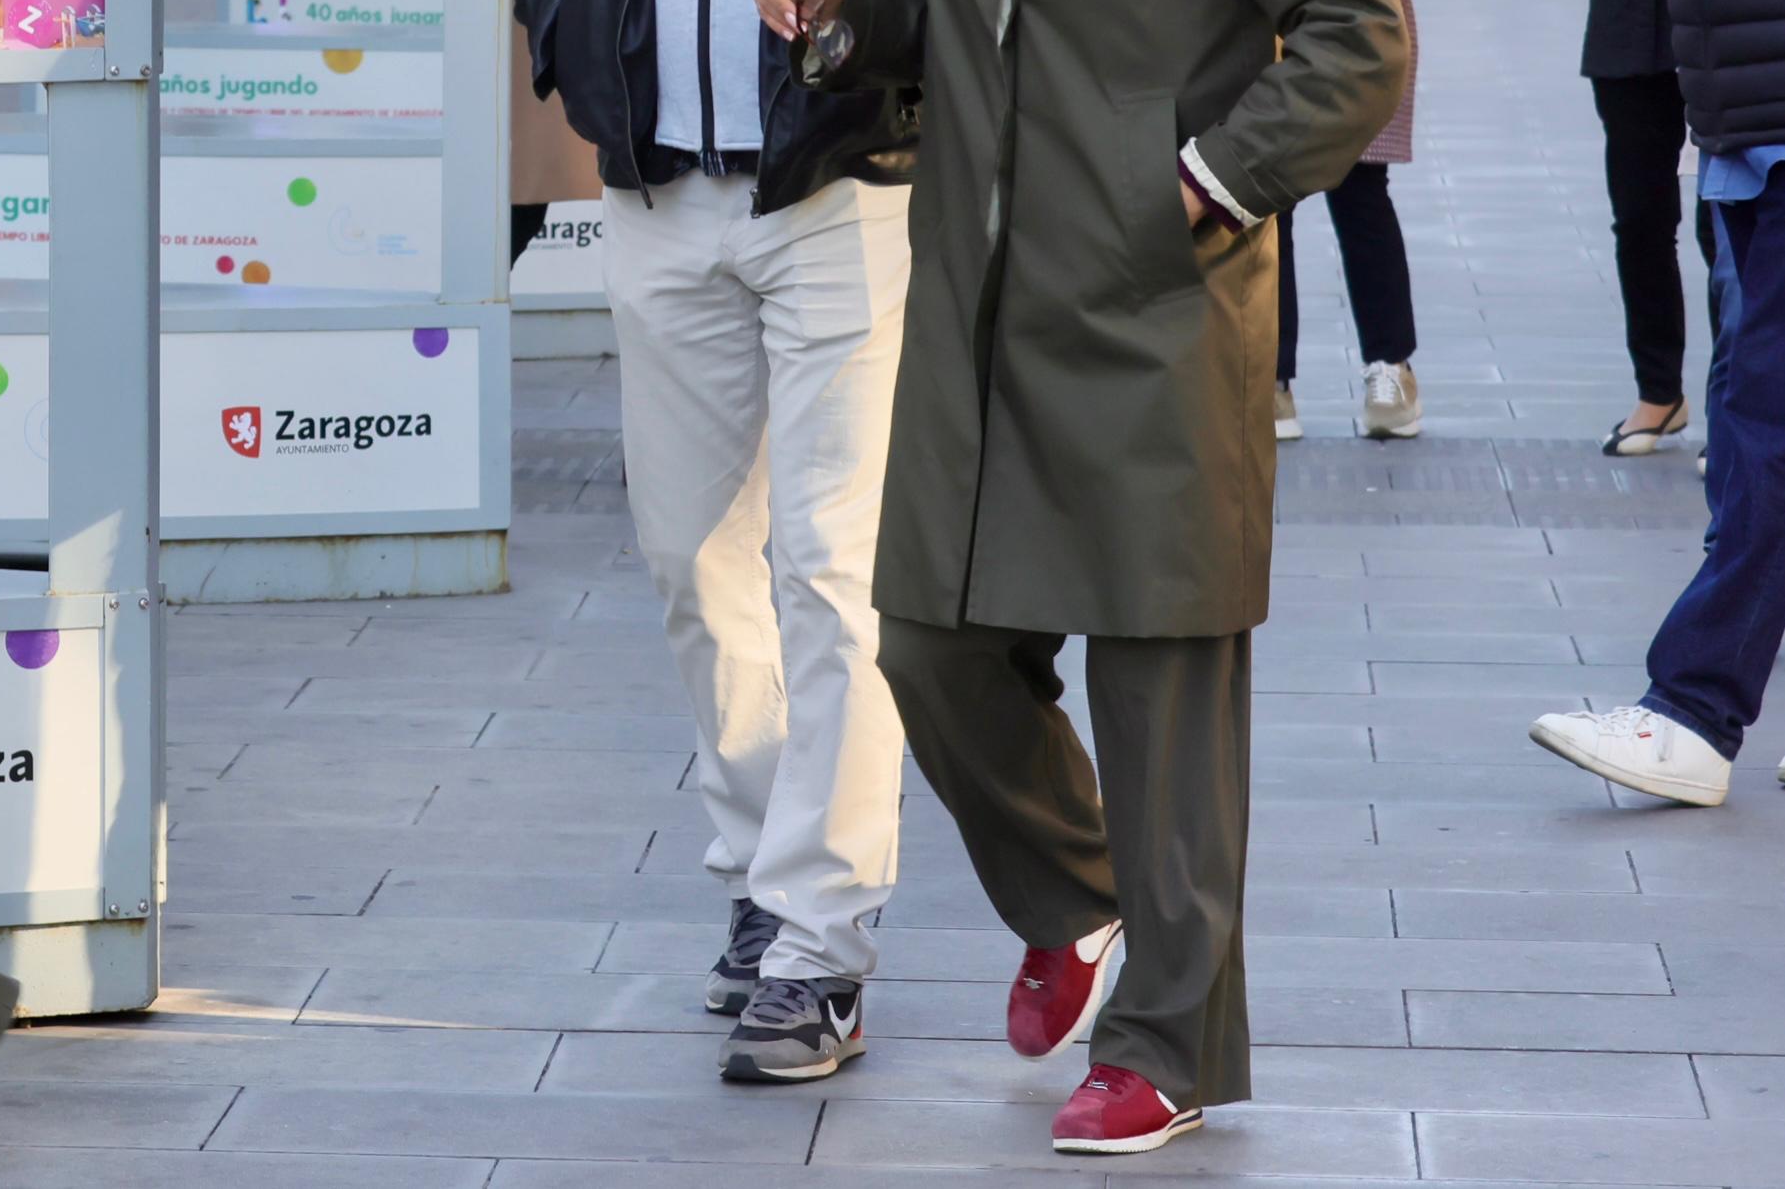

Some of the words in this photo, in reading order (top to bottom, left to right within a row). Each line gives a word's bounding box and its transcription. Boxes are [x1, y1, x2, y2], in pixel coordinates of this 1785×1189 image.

[306, 3, 332, 22] 40
[336, 6, 382, 24] años
[216, 74, 318, 102] jugando
[174, 235, 188, 245] DE
[192, 235, 258, 246] ZARAGOZA
[274, 410, 432, 450] Zaragoza
[276, 444, 350, 455] AYUNTAMIENTO
